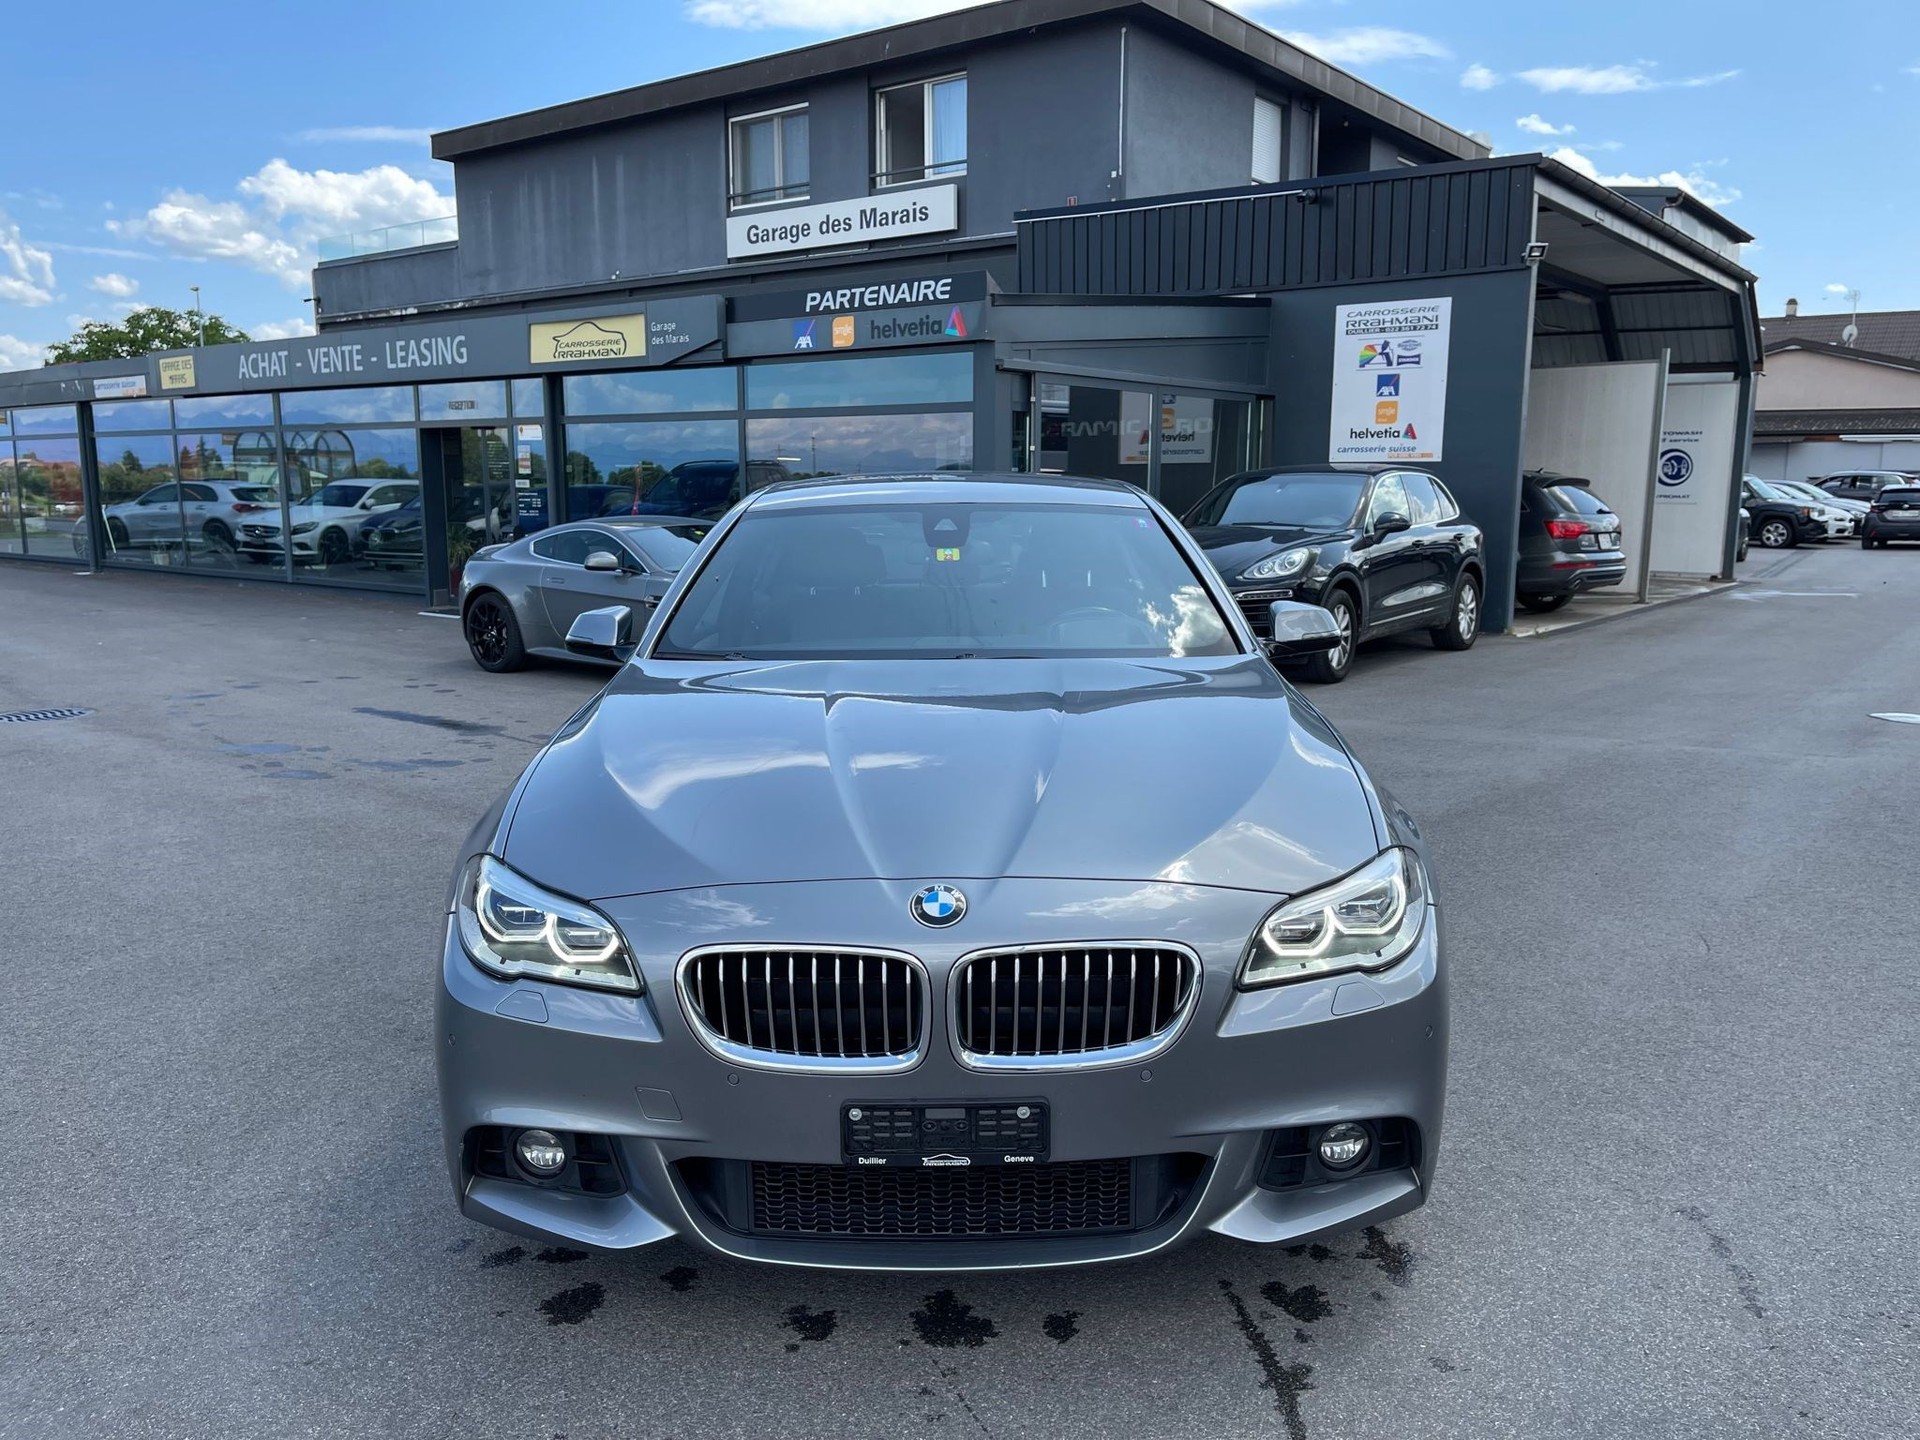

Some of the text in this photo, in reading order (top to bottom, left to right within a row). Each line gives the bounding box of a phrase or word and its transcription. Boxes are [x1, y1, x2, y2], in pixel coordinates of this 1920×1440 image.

[746, 202, 929, 244] Garage des Marais
[805, 278, 952, 313] PARTENAIRE
[1347, 305, 1440, 318] CARROSSERIE
[650, 322, 676, 333] Garage
[870, 314, 942, 339] helvetia
[558, 338, 621, 349] CARROSSERIE
[651, 333, 690, 345] des Marais
[794, 335, 814, 349] AXA
[238, 350, 289, 380] ACHAT
[307, 344, 364, 374] VENTE
[385, 335, 468, 369] LEASING
[1376, 385, 1396, 396] AXA
[1349, 427, 1401, 439] helvetia
[1337, 443, 1417, 453] carrosserie suisse
[918, 885, 963, 898] BMW
[858, 1157, 887, 1165] Duillier
[1003, 1155, 1035, 1163] Geneve
